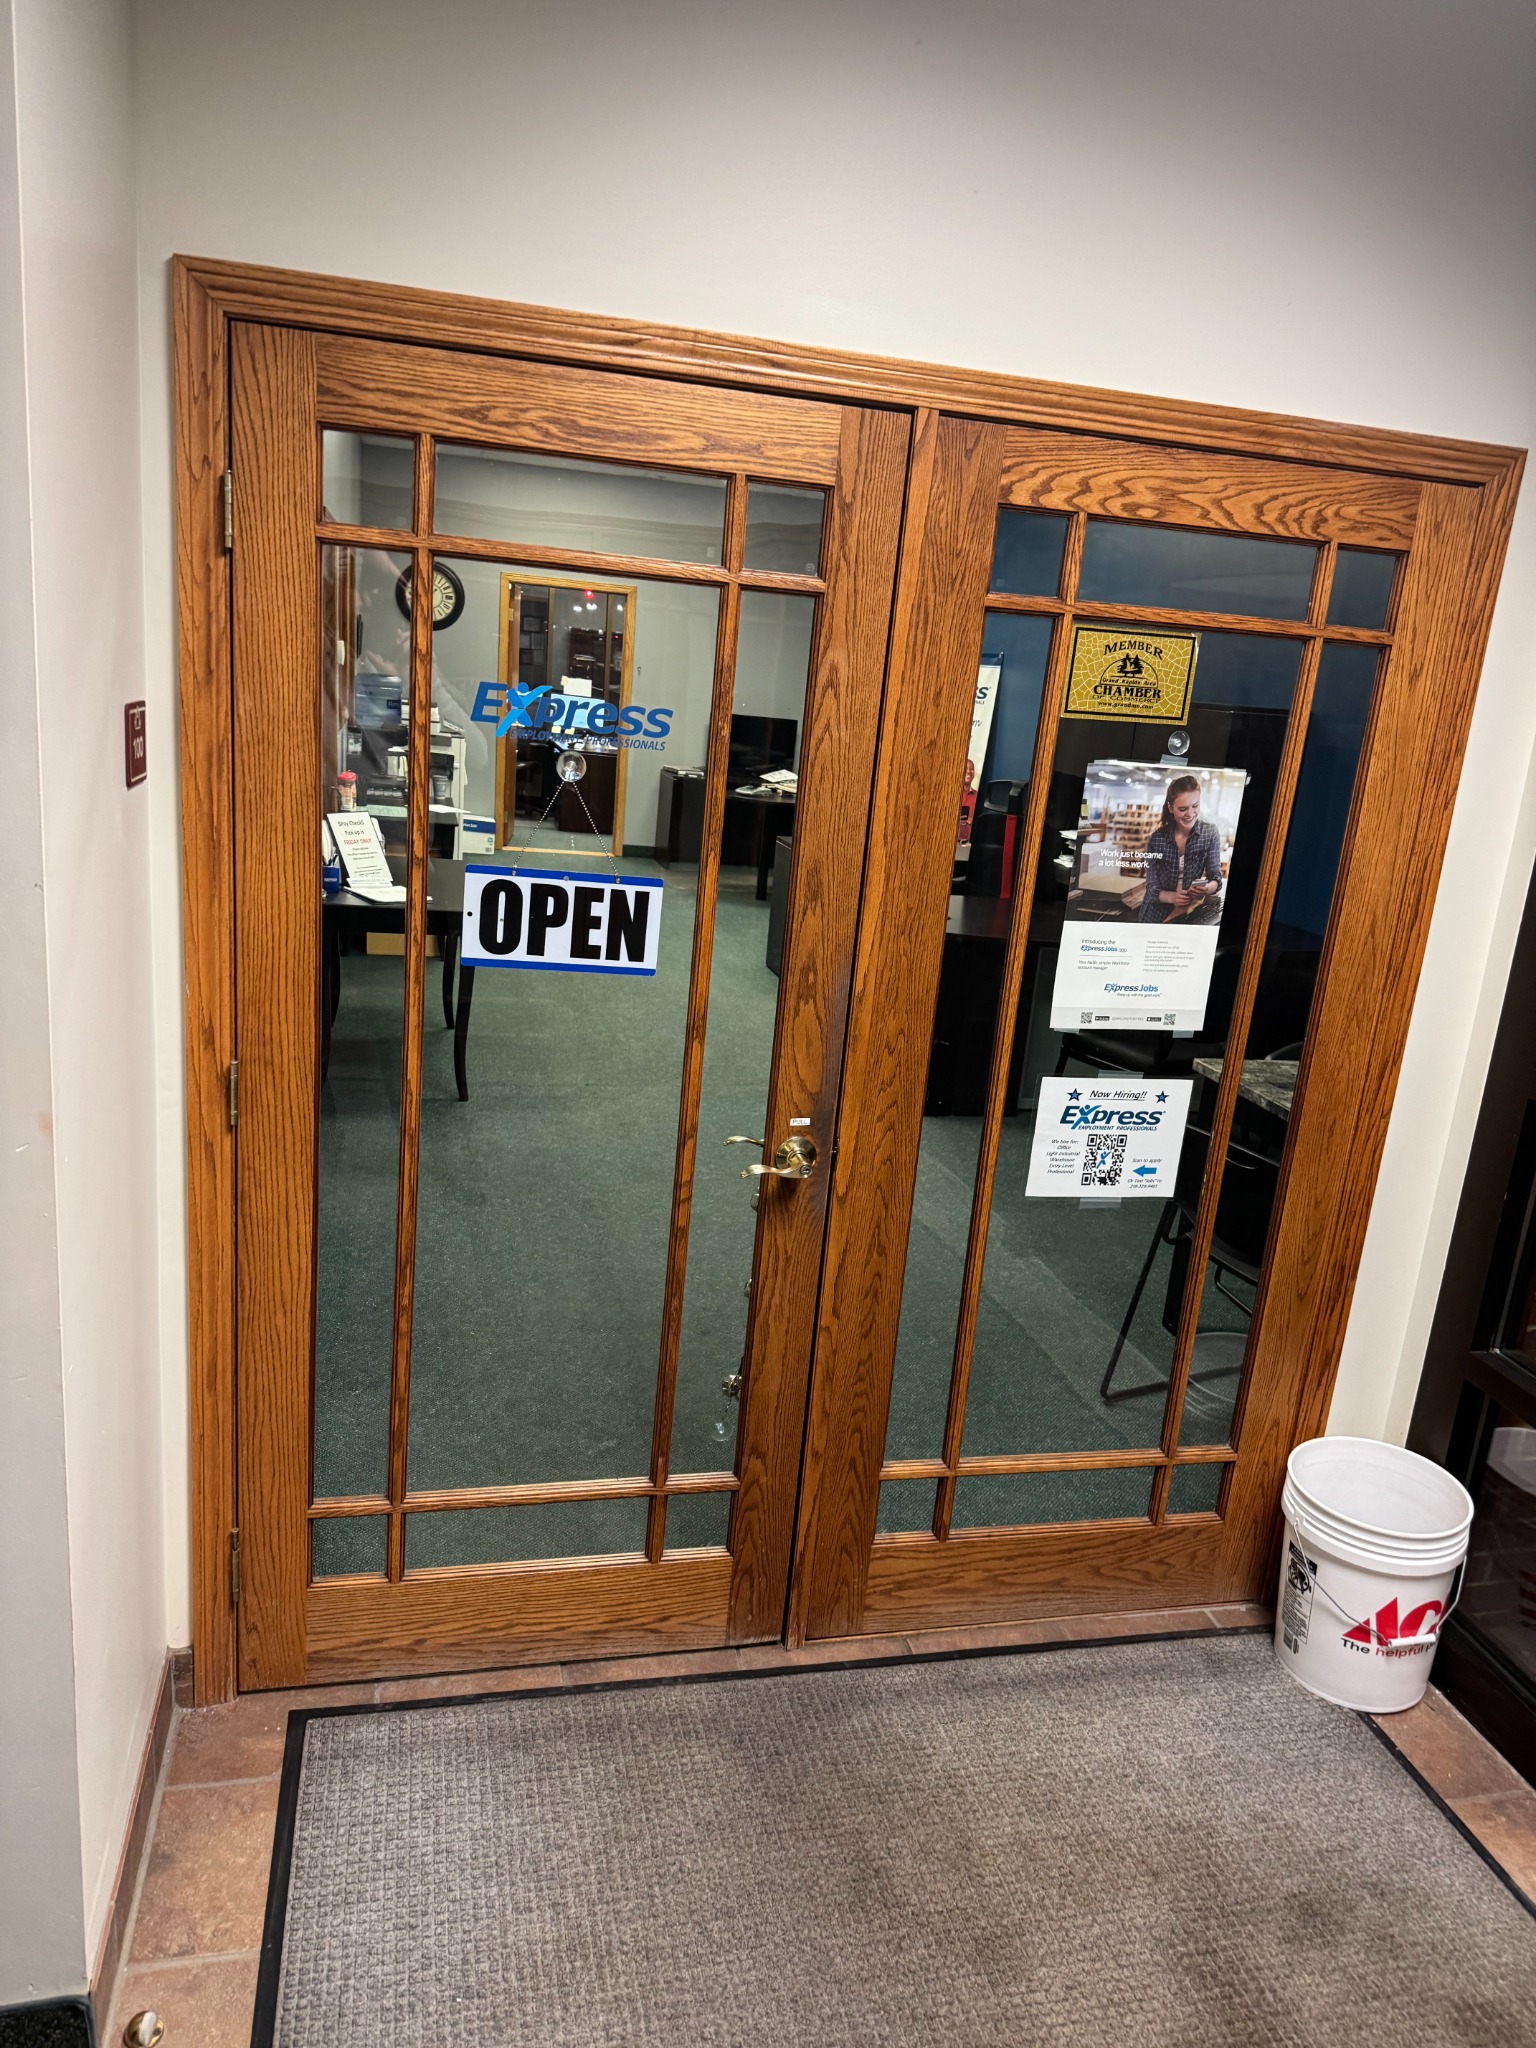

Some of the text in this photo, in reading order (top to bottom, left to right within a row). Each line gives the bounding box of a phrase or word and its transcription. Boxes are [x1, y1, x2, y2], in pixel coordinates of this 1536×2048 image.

[1103, 640, 1163, 660] MEMBER
[1093, 685, 1161, 699] CHAMBER
[470, 681, 674, 738] Express
[509, 728, 666, 751] EMPLOYMENT PROFESSIONALS
[1100, 848, 1163, 859] Work just became
[1104, 859, 1114, 867] lot
[1115, 859, 1130, 867] less
[1130, 860, 1150, 868] work.
[479, 879, 650, 962] OPEN
[1089, 1089, 1148, 1100] Now Hiring!!
[1060, 1104, 1163, 1129] Express
[1342, 1597, 1450, 1647] AC
[1340, 1637, 1370, 1654] The
[1375, 1644, 1424, 1659] helpful
